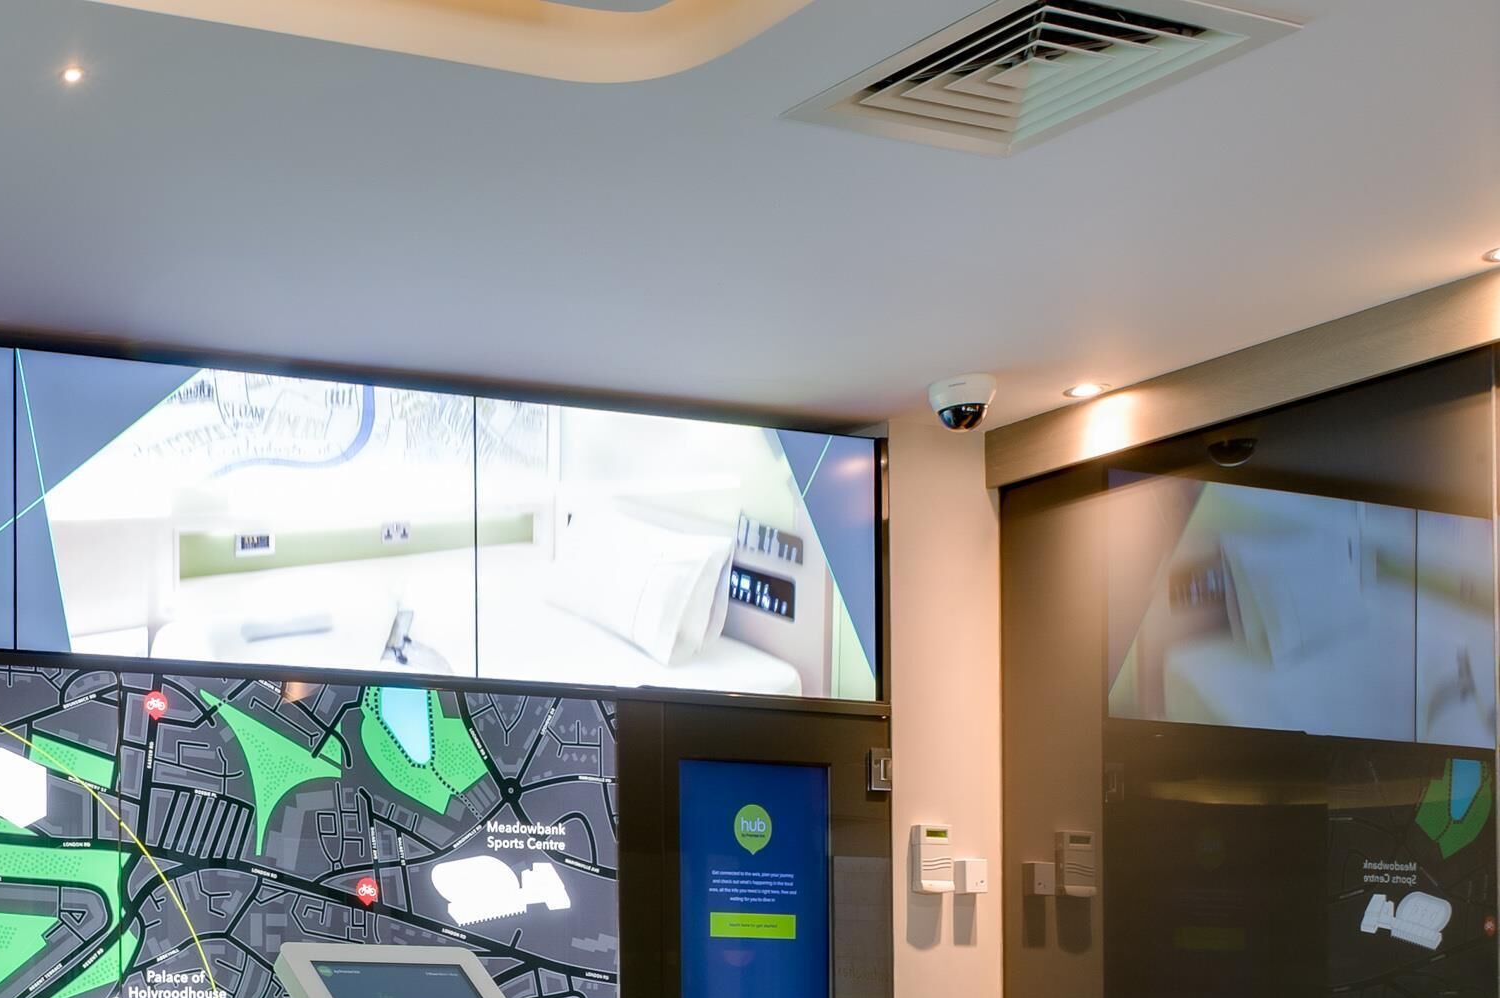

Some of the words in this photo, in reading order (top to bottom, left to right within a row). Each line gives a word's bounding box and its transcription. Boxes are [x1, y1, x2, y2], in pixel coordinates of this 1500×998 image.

[487, 821, 565, 835] Meadowbank
[741, 817, 766, 832] hub
[487, 836, 524, 851] Sports
[527, 838, 565, 850] Centre
[147, 971, 188, 984] Palace
[192, 970, 206, 982] of
